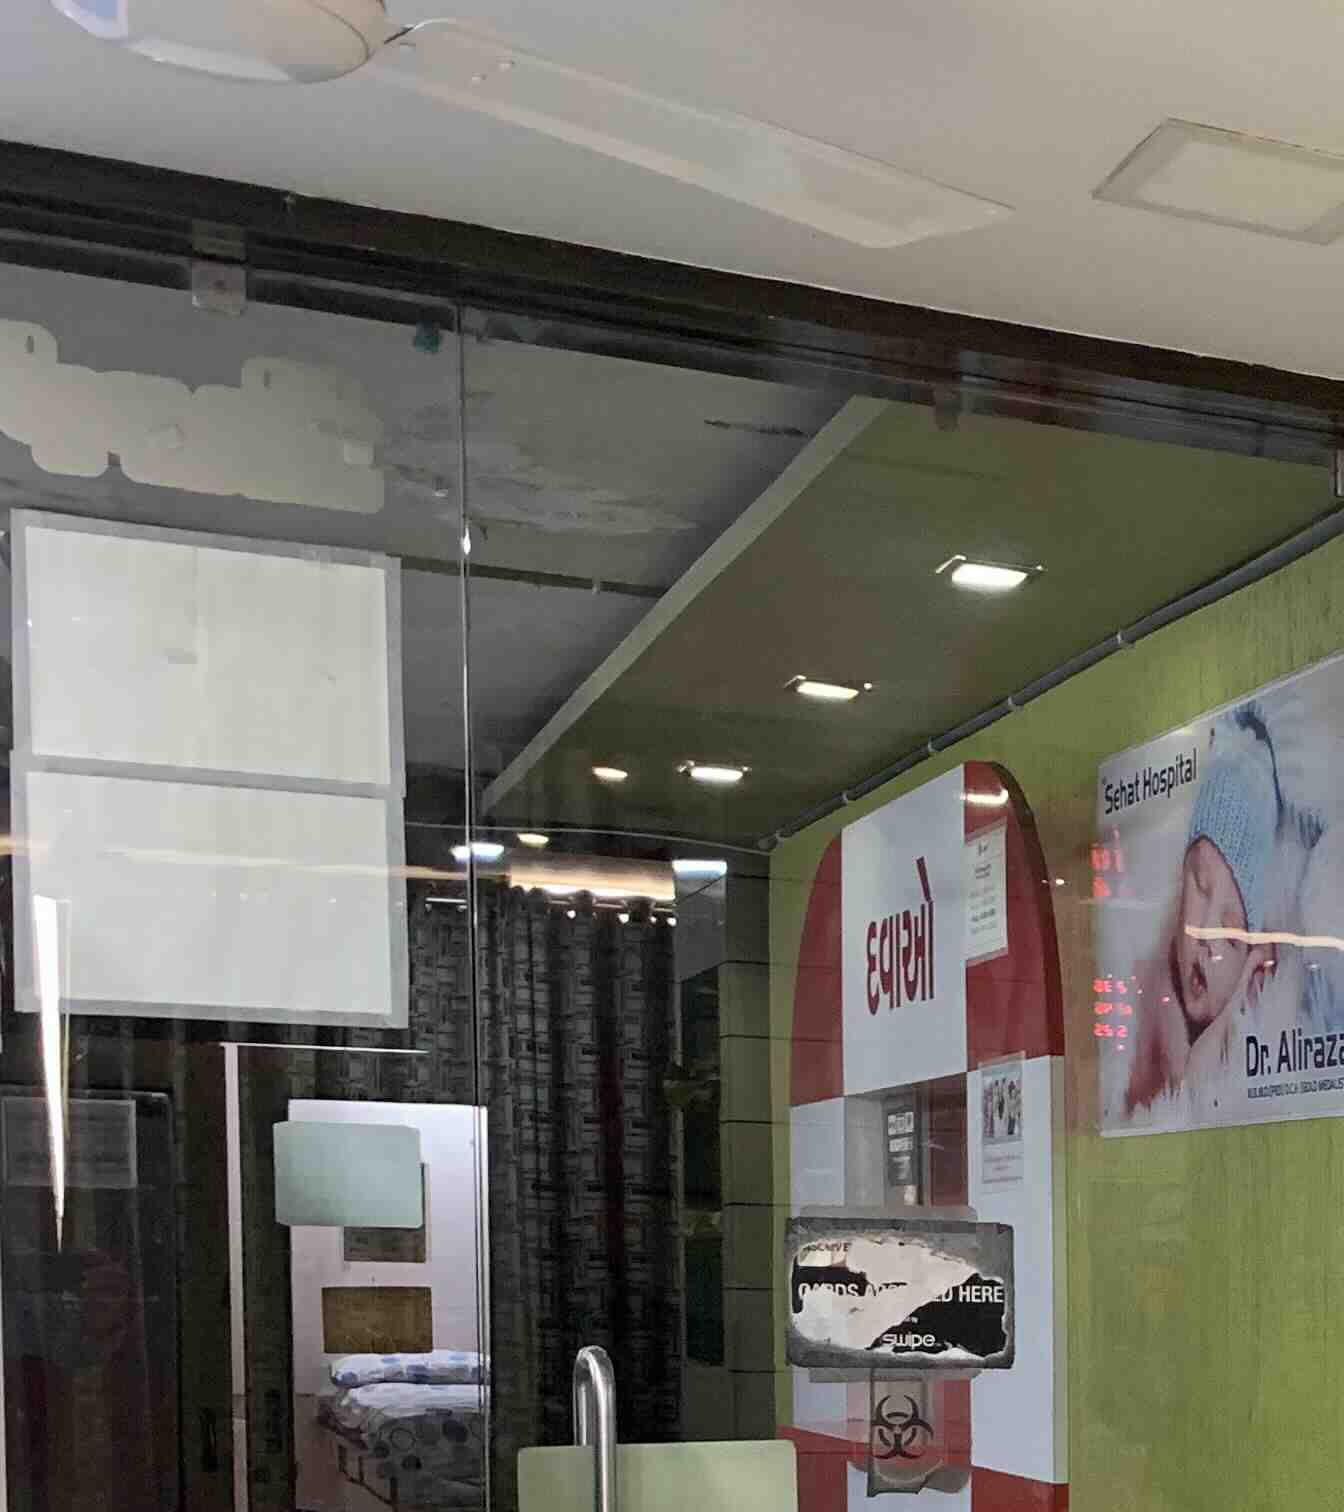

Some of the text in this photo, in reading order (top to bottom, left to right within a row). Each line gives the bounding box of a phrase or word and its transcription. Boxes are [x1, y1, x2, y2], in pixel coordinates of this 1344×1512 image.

[1105, 747, 1197, 814] Sehat Hospital
[1246, 1035, 1271, 1077] Dr.
[959, 1286, 1004, 1303] HERE
